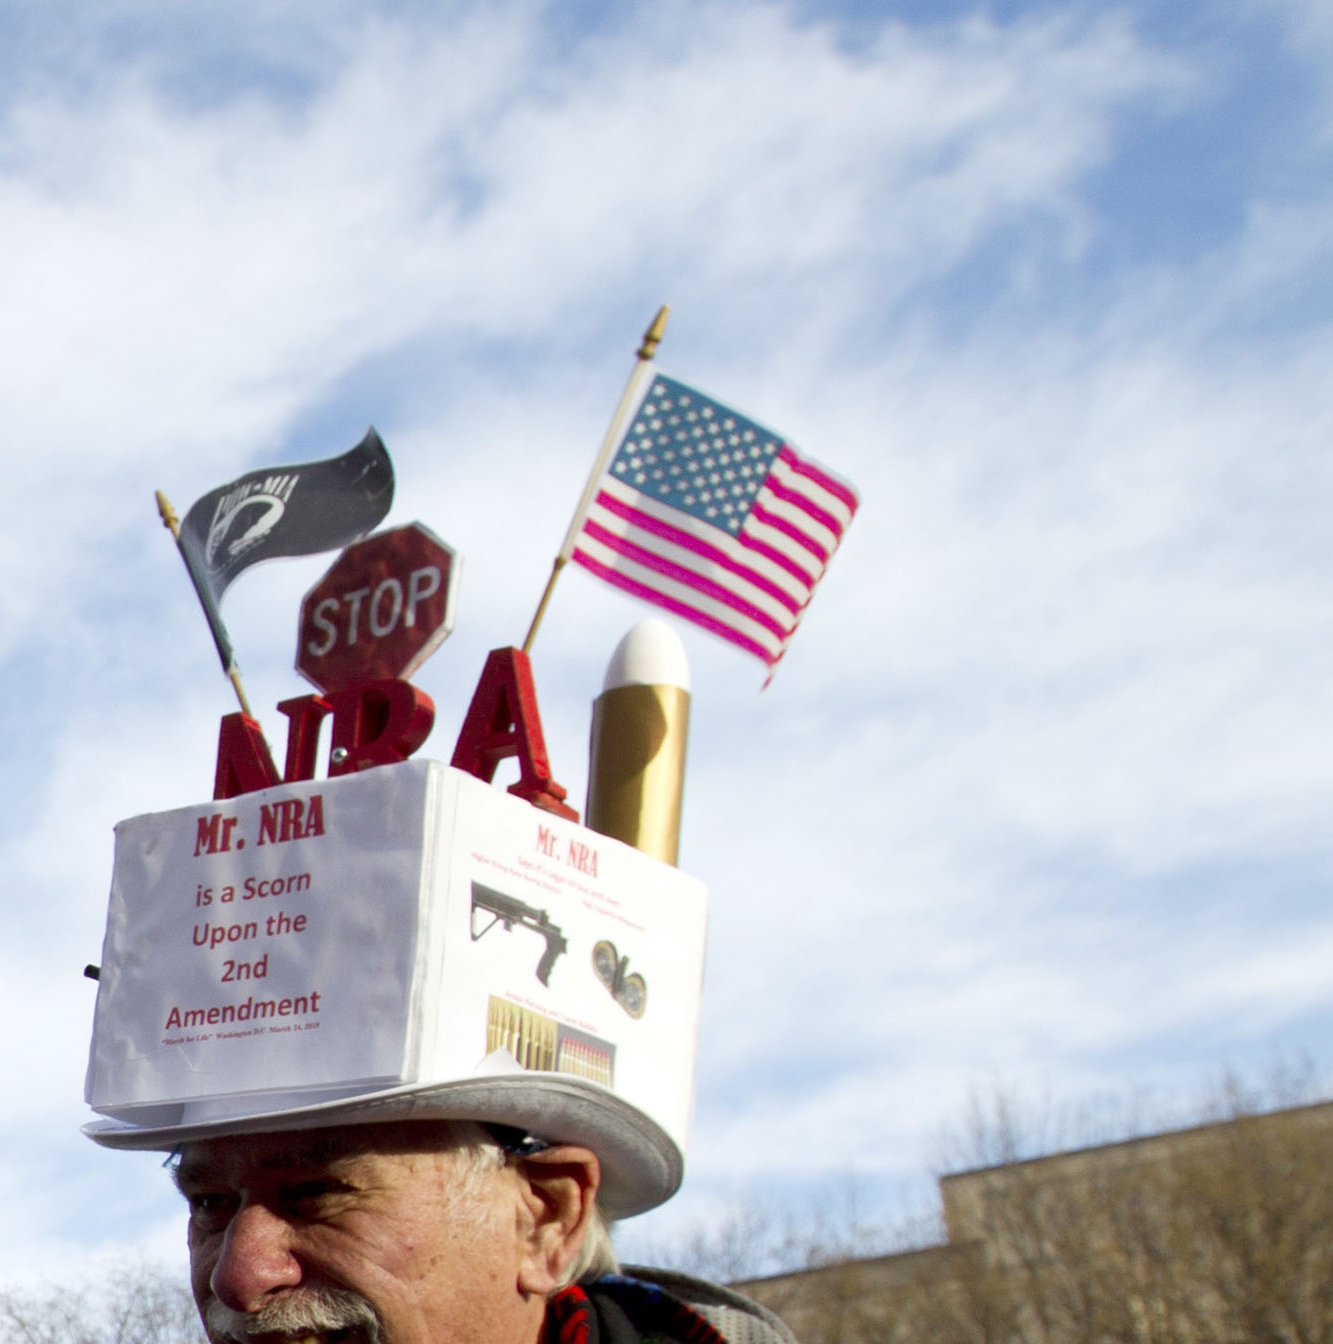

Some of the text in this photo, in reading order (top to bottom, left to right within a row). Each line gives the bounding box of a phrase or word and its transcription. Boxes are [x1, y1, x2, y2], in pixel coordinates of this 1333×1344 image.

[307, 566, 441, 657] STOP
[213, 646, 579, 823] NRA
[193, 795, 326, 857] Mr. NRA
[535, 823, 560, 862] Mr.
[566, 839, 599, 879] NRA
[196, 872, 312, 907] is a Scorn
[192, 910, 308, 950] Upon the
[221, 953, 269, 982] 2nd
[165, 990, 321, 1030] Amendment
